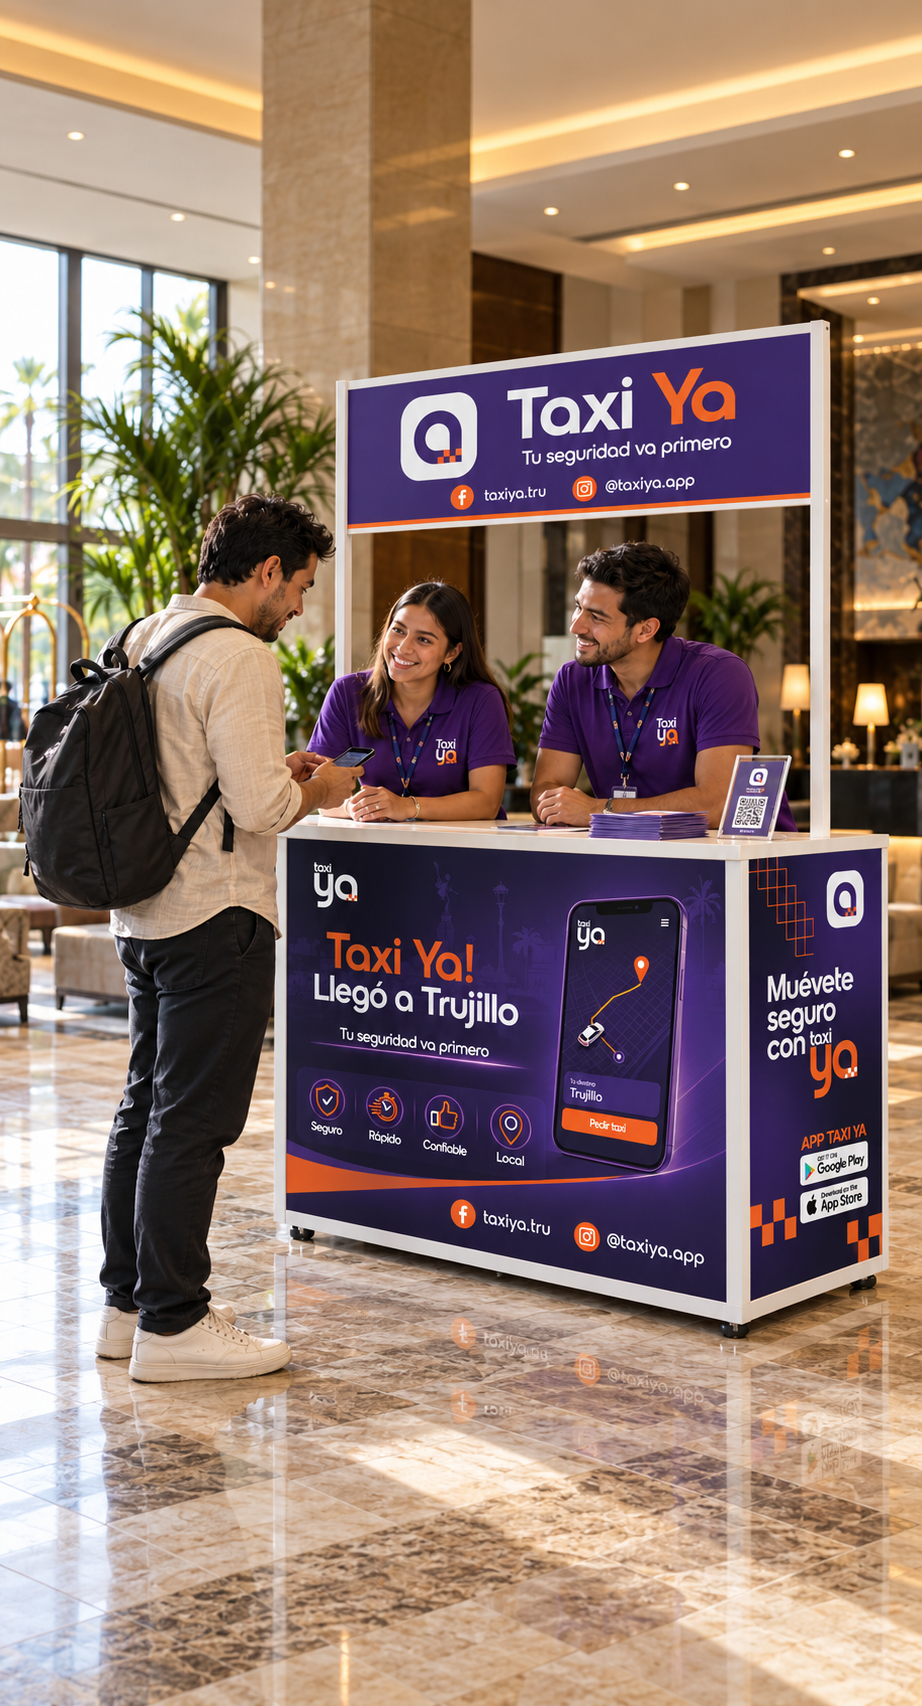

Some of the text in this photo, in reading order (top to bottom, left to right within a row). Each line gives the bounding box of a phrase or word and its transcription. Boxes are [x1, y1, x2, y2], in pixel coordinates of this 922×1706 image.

[507, 367, 736, 439] Taxi Ya
[522, 436, 732, 467] Tu seguridad va primero
[484, 486, 547, 502] taxiya.tru
[605, 474, 695, 494] @taxiya.app
[313, 861, 332, 873] taxi
[313, 872, 358, 908] ya
[577, 927, 605, 950] ya
[326, 931, 474, 984] Taxi Ya!
[767, 966, 854, 1003] Muévete
[313, 973, 519, 1029] Llegó a Trujillo
[767, 1002, 837, 1034] seguro
[339, 1027, 490, 1058] Tu seguridad va primero
[767, 1034, 806, 1061] con
[809, 1027, 833, 1047] taxi
[809, 1039, 858, 1100] ya
[569, 1086, 603, 1103] Trujillo
[310, 1121, 343, 1136] Seguro
[368, 1129, 402, 1146] Rápido
[800, 1123, 867, 1151] APP TAXI YA
[422, 1139, 468, 1157] Confiable
[496, 1151, 525, 1167] Local
[817, 1157, 847, 1174] Google
[847, 1154, 865, 1167] Play
[820, 1192, 863, 1213] App Store
[483, 1210, 551, 1236] taxiya.tru
[606, 1233, 705, 1268] @taxiya.app
